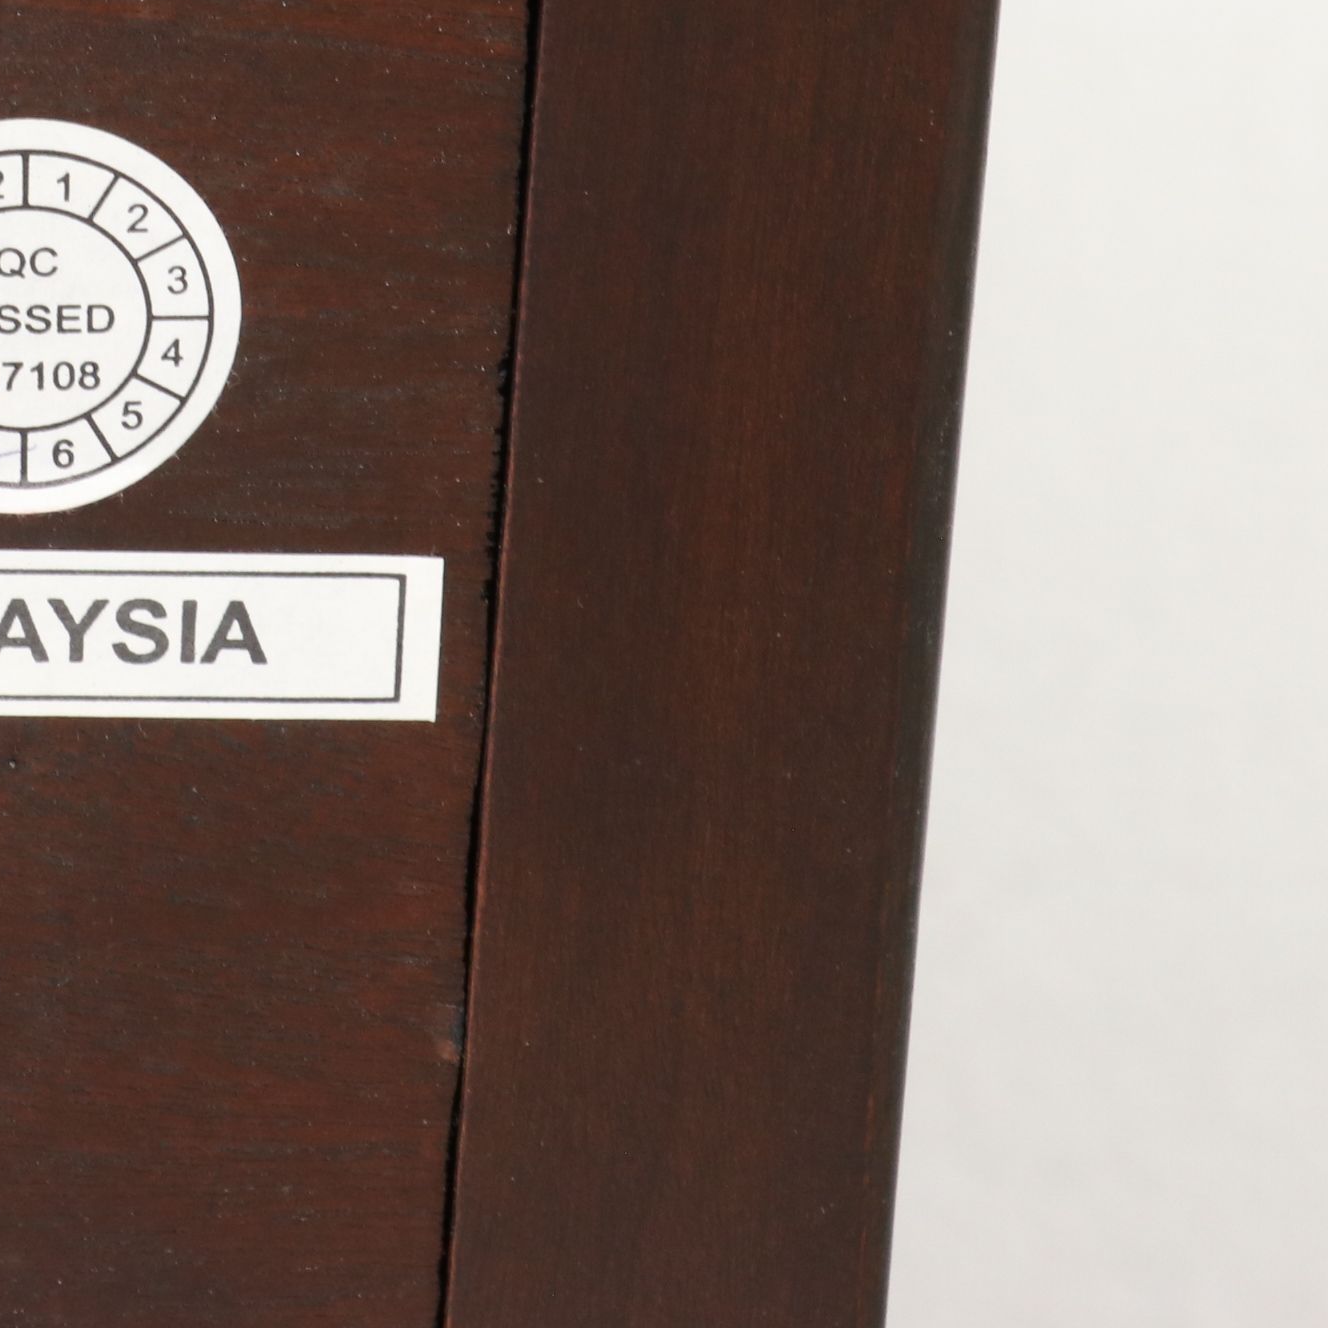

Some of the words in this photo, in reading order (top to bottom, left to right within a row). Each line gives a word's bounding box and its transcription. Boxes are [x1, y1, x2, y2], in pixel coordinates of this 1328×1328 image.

[57, 172, 70, 202] 1
[127, 203, 149, 233] 2
[167, 265, 189, 295] 3
[160, 338, 183, 367] 4
[121, 400, 143, 430] 5
[52, 439, 75, 469] 6
